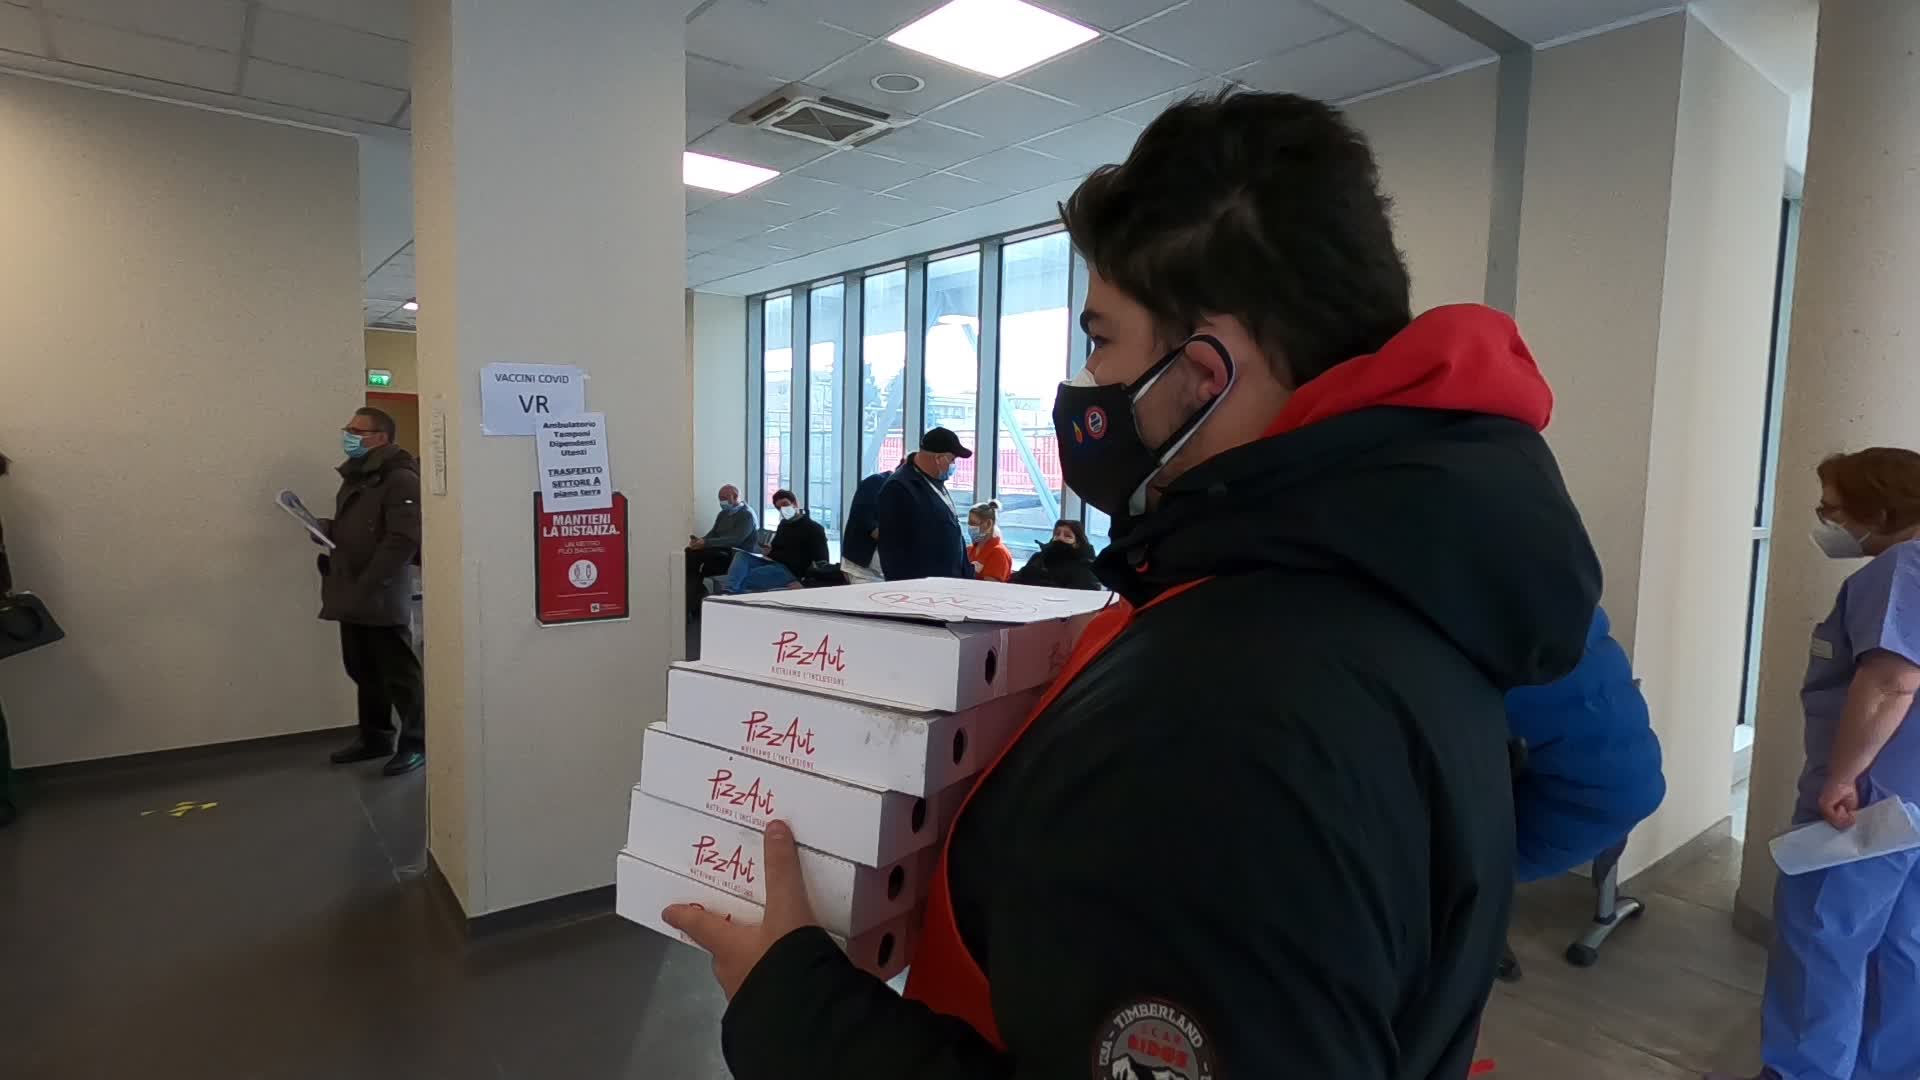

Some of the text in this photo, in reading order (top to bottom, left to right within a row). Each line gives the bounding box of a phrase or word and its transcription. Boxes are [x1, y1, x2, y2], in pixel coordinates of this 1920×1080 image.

[494, 373, 569, 384] VACCINI COVID
[518, 394, 550, 413] VR
[543, 421, 596, 429] Ambulatorio
[553, 430, 591, 438] Tamponi
[548, 466, 603, 477] TRASFERITO
[552, 476, 601, 489] SETTORE A
[552, 513, 611, 526] MANTIENI
[543, 524, 620, 537] LA DISTANZA.
[1113, 1003, 1204, 1048] TIMBERLAND
